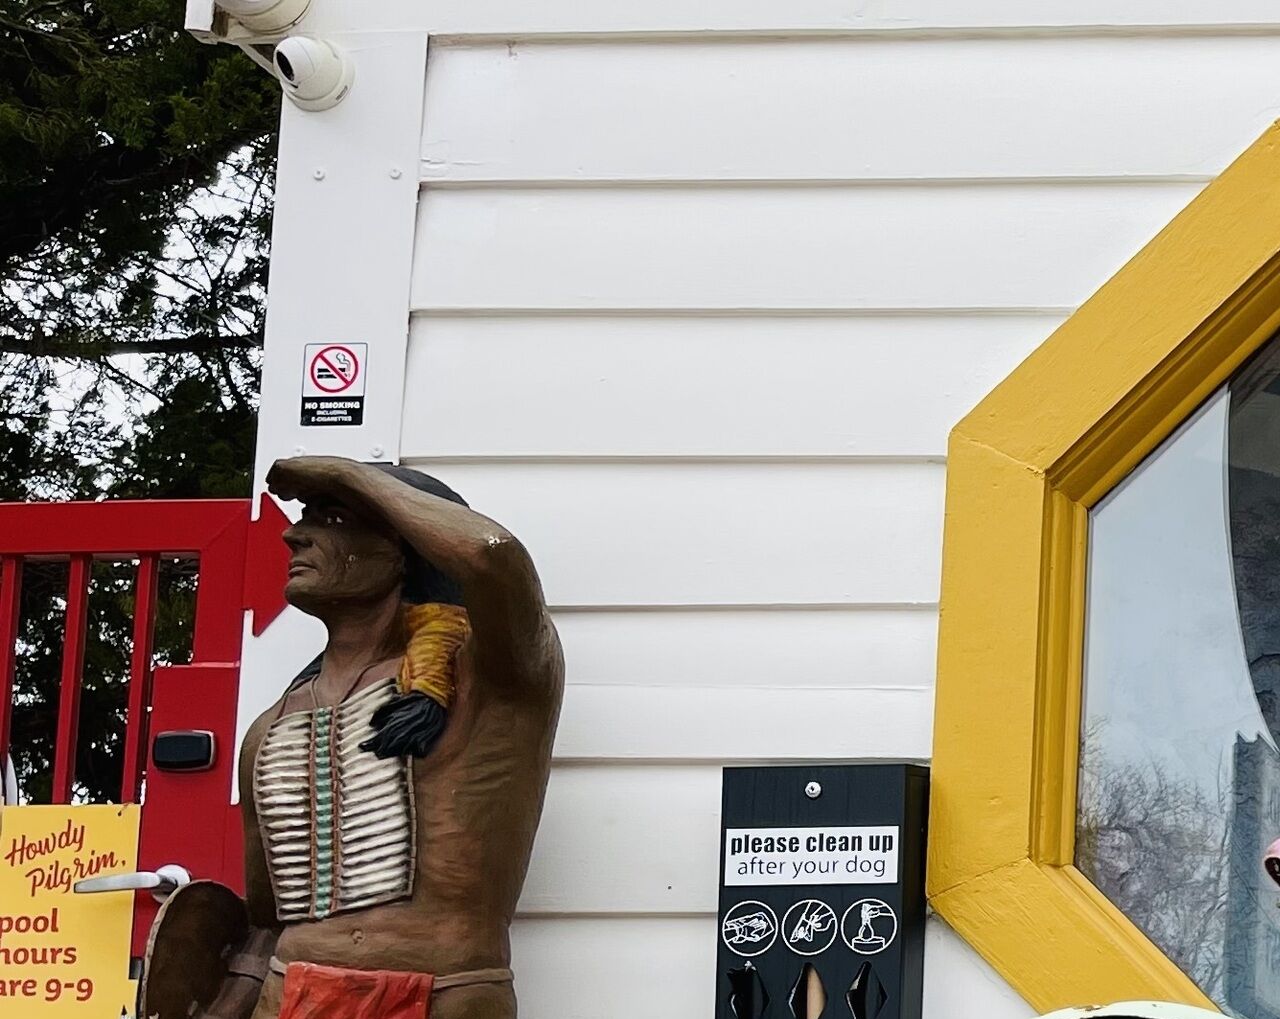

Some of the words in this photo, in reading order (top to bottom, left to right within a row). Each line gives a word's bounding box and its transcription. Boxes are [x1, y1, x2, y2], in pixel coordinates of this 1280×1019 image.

[304, 402, 318, 410] NO
[320, 401, 360, 409] SMOKING
[5, 819, 85, 867] Howdy
[731, 834, 800, 856] please
[806, 833, 862, 852] clean
[869, 835, 893, 853] up
[737, 857, 786, 875] after
[792, 859, 839, 879] your
[845, 855, 885, 877] dog
[0, 908, 59, 938] pool
[45, 978, 93, 1002] 9-9
